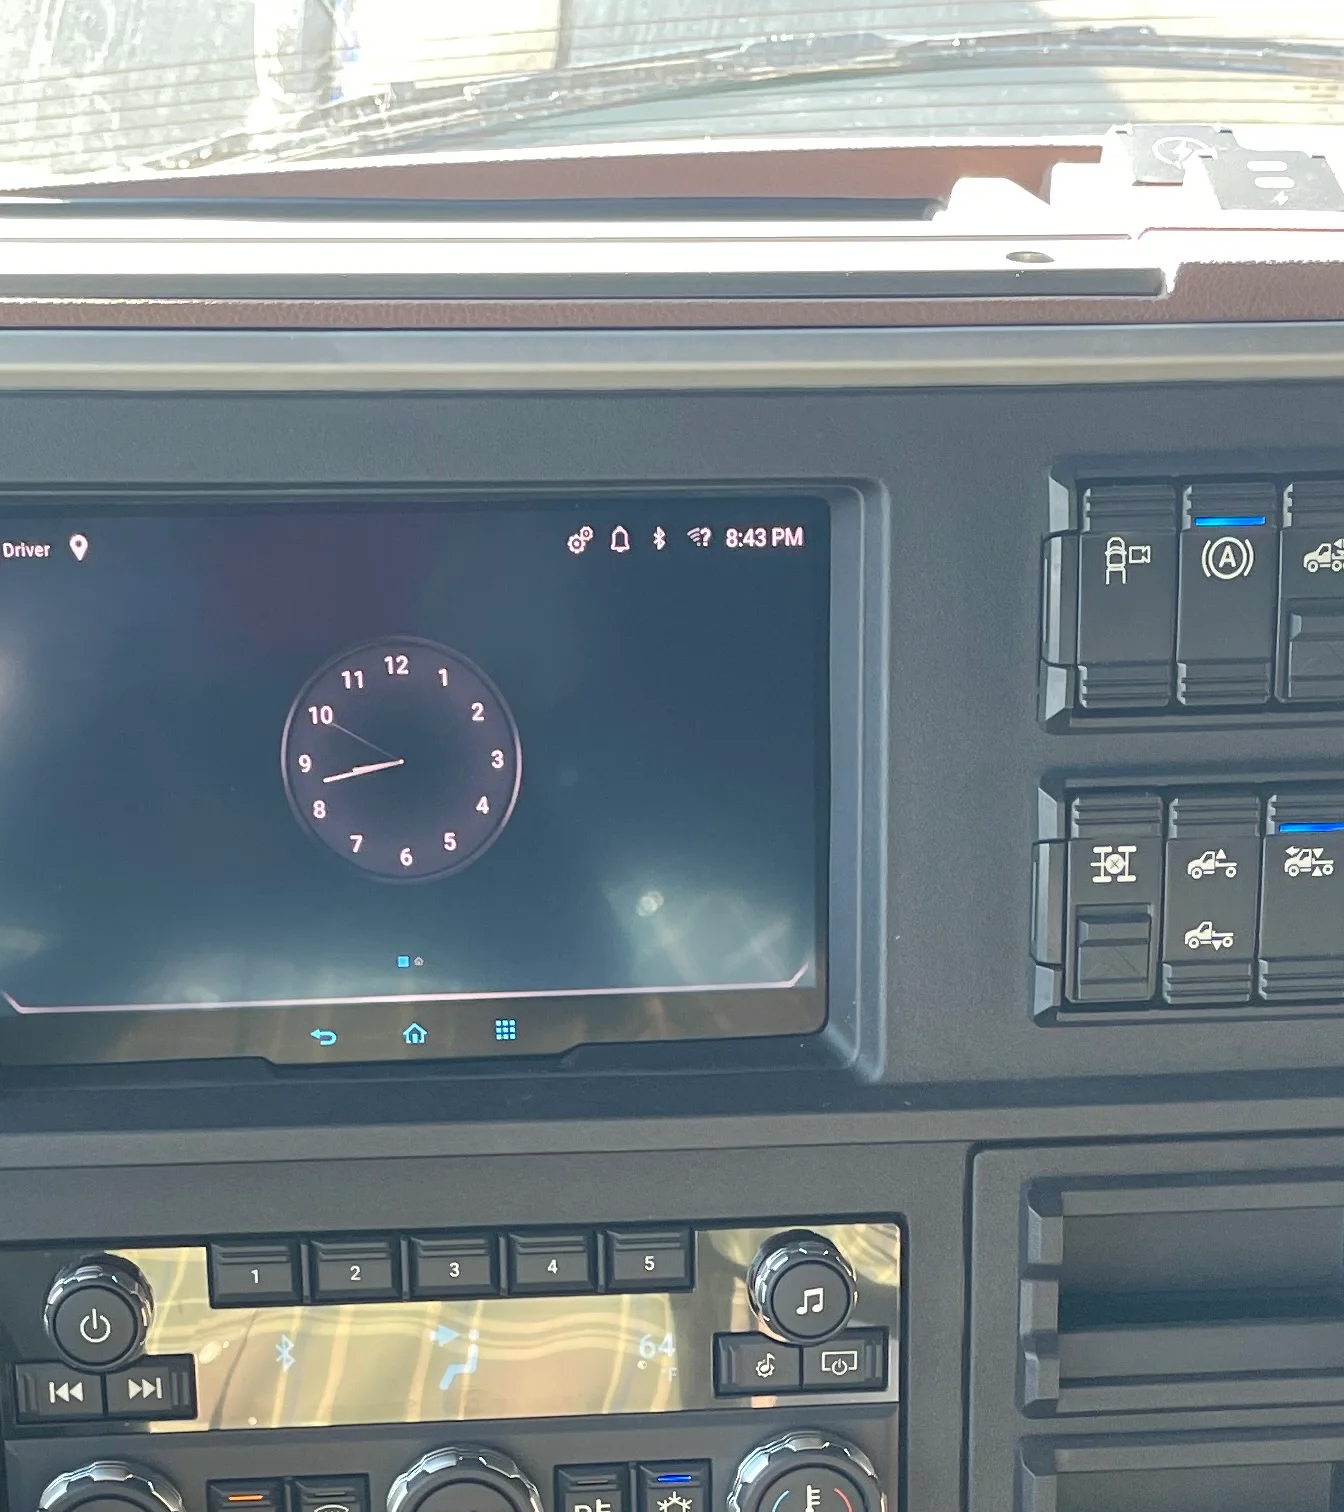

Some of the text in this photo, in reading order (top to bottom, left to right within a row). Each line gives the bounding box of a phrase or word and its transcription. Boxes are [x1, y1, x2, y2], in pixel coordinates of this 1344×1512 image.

[725, 526, 804, 548] 8:43 PM
[2, 542, 51, 558] Driver
[384, 655, 409, 675] 12
[341, 670, 365, 689] 11
[437, 668, 449, 687] 1
[308, 705, 334, 725] 10
[470, 702, 485, 721] 2
[298, 754, 312, 773] 9
[490, 749, 505, 769] 3
[312, 799, 327, 819] 8
[475, 795, 490, 815] 4
[349, 834, 364, 853] 7
[443, 832, 457, 851] 5
[399, 847, 413, 867] 6
[449, 1262, 460, 1279] 3
[546, 1259, 559, 1275] 4
[644, 1255, 655, 1271] 5
[250, 1268, 260, 1285] 1
[349, 1265, 362, 1281] 2
[639, 1332, 676, 1359] 64
